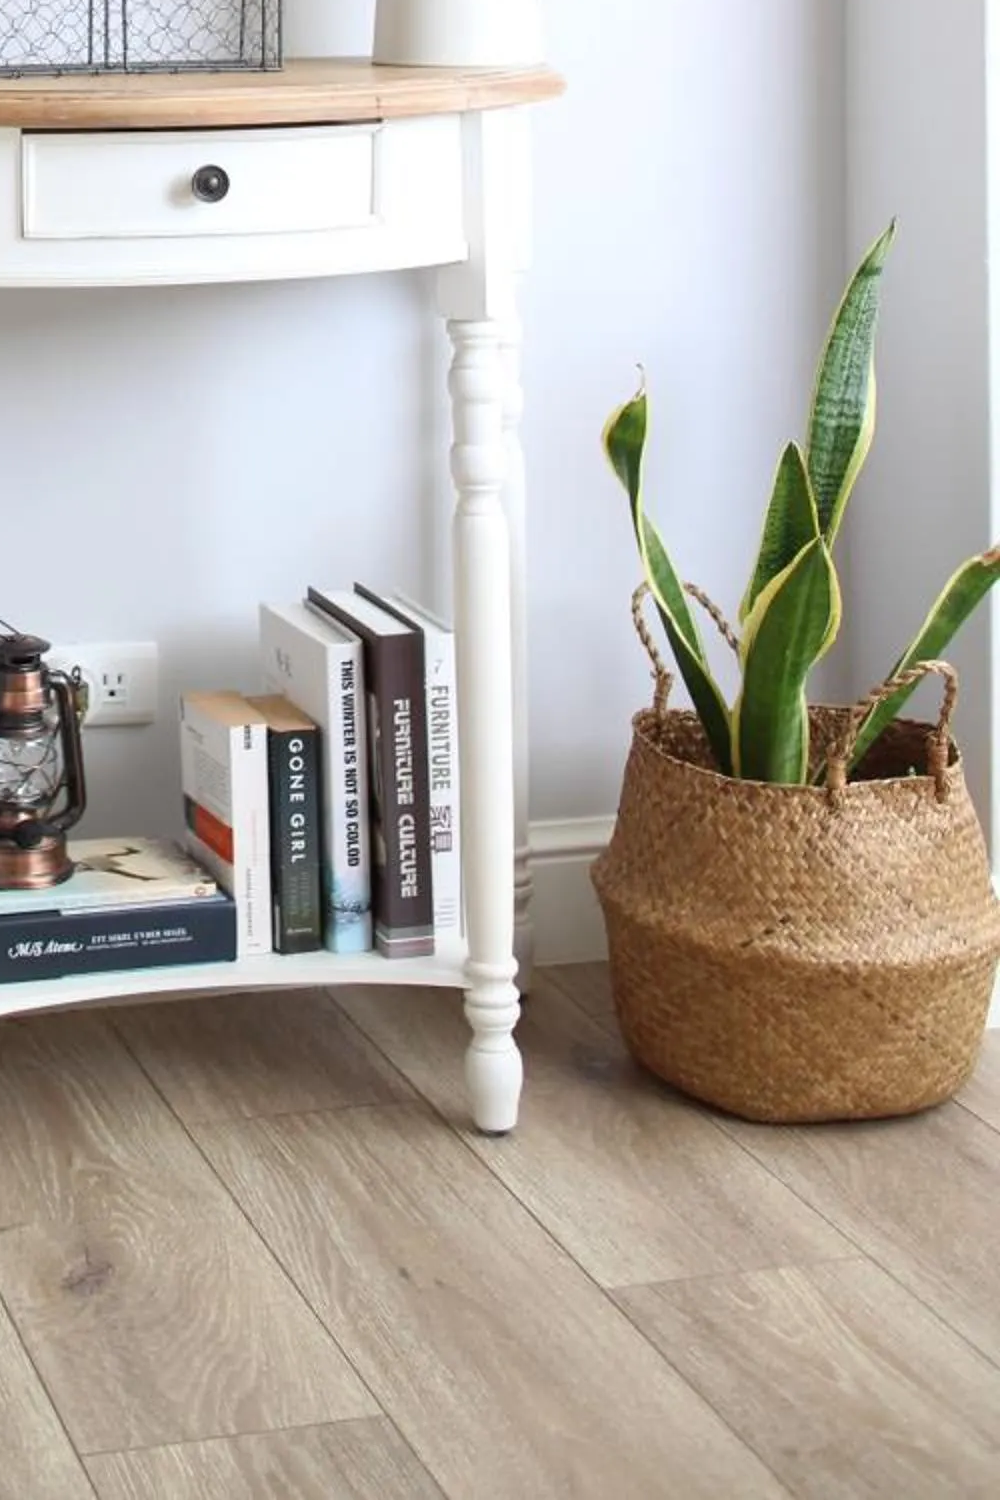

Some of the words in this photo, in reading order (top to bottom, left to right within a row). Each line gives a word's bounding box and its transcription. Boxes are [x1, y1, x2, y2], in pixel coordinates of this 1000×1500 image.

[340, 659, 354, 691] THIS
[341, 693, 356, 747] WINTER
[431, 685, 451, 791] FURNITURE
[288, 738, 305, 803] GONE
[343, 750, 357, 765] IS
[345, 799, 359, 818] SO
[289, 813, 306, 864] GIRL
[397, 813, 418, 899] CULTURE
